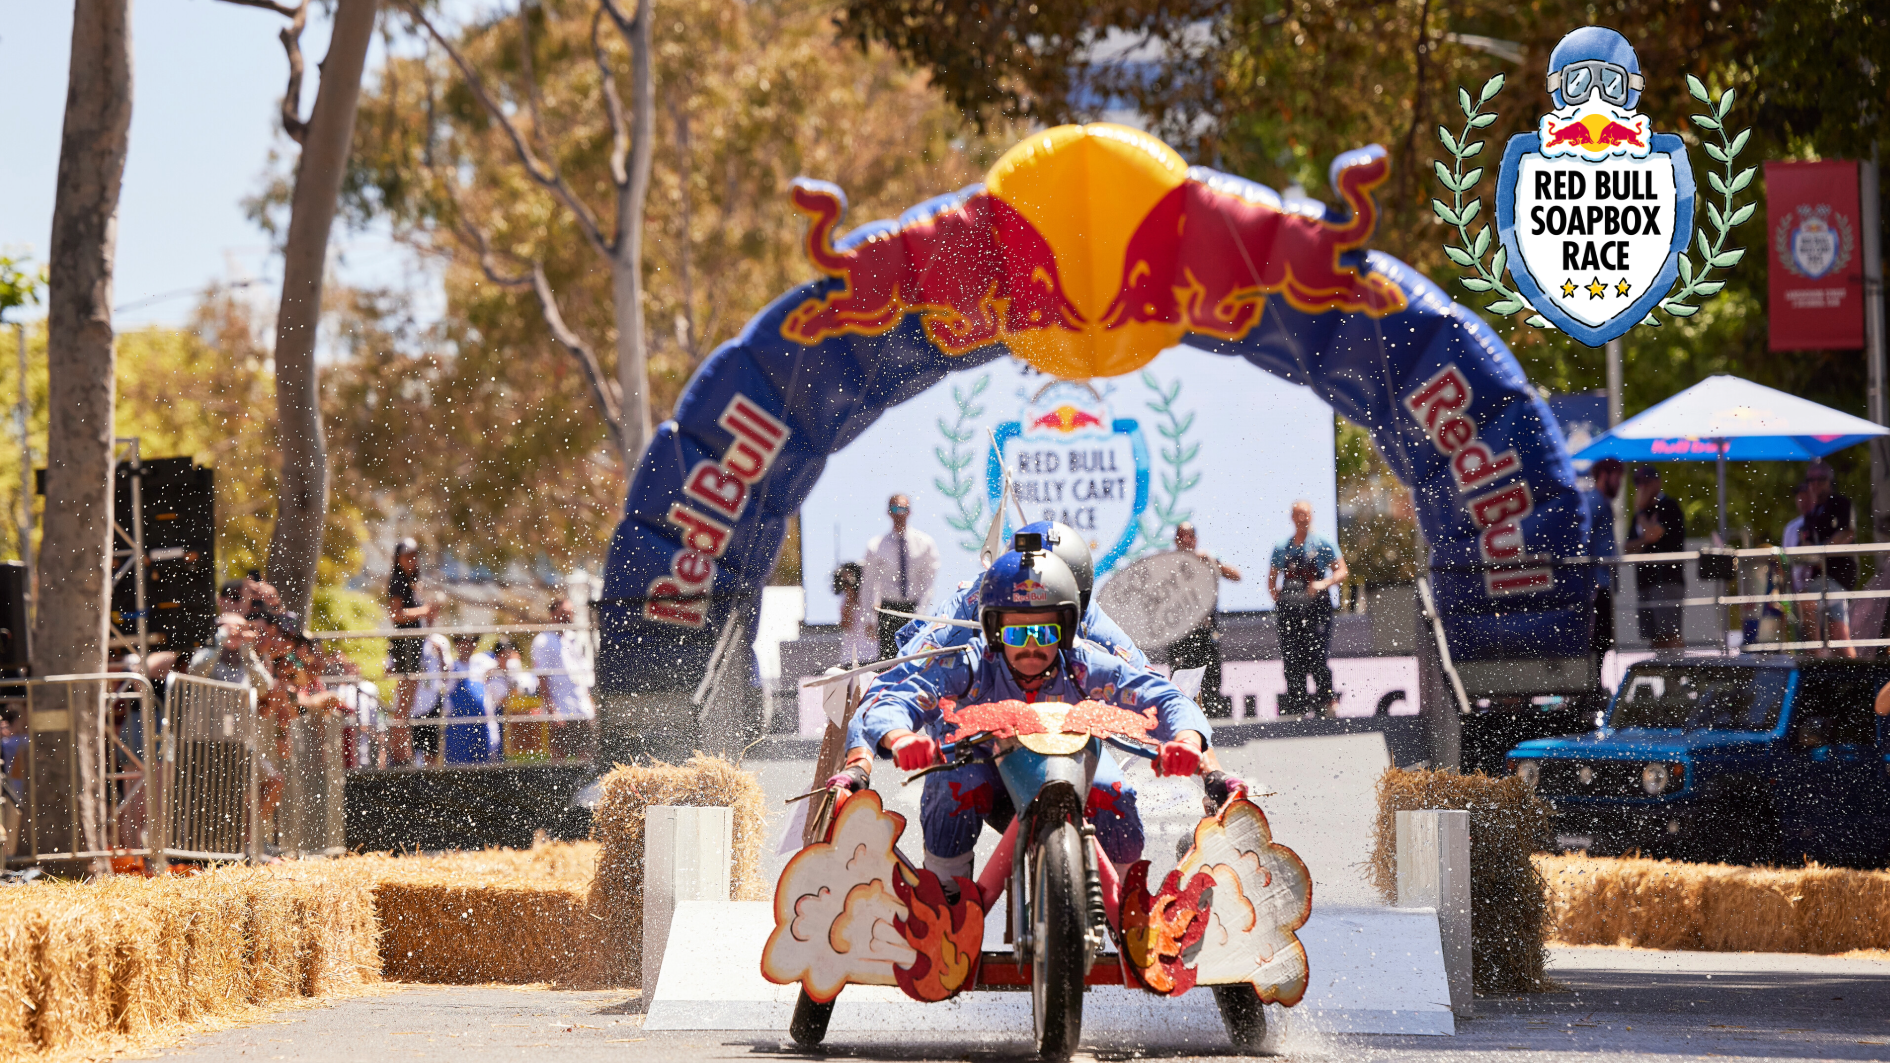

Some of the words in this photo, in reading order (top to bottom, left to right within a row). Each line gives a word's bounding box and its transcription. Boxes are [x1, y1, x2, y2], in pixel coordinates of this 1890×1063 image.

[685, 395, 790, 520] Bull
[1019, 450, 1060, 473] RED
[1068, 450, 1117, 473] BULL
[1072, 477, 1127, 501] CART
[1406, 364, 1520, 491] Red
[1469, 480, 1555, 596] Bull
[645, 505, 734, 627] Red
[1012, 592, 1030, 602] Red
[1031, 592, 1047, 601] Bull
